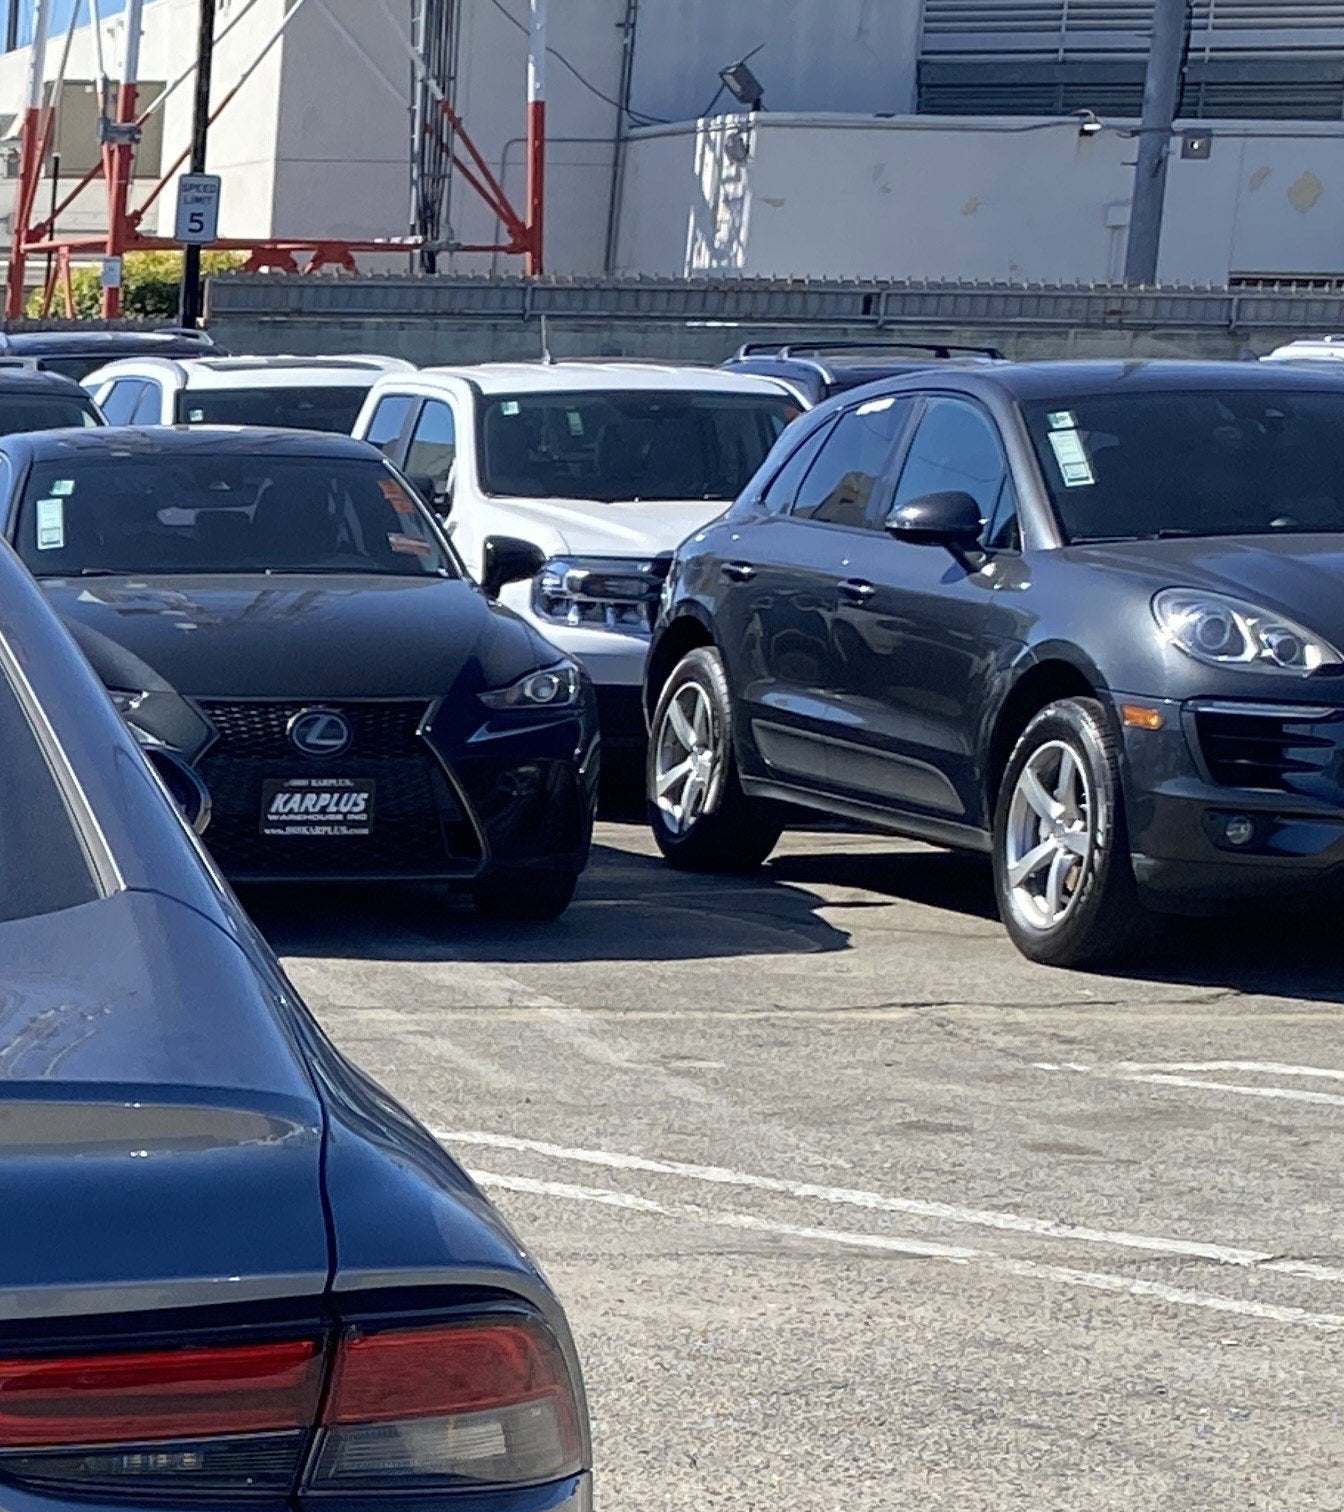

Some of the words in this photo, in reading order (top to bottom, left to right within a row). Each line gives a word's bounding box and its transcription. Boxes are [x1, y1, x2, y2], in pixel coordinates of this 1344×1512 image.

[182, 182, 217, 193] SPEED
[183, 194, 214, 205] LIMIT
[188, 212, 204, 234] 5
[270, 793, 370, 813] KARPLUS
[267, 813, 344, 821] WAREHOUSE
